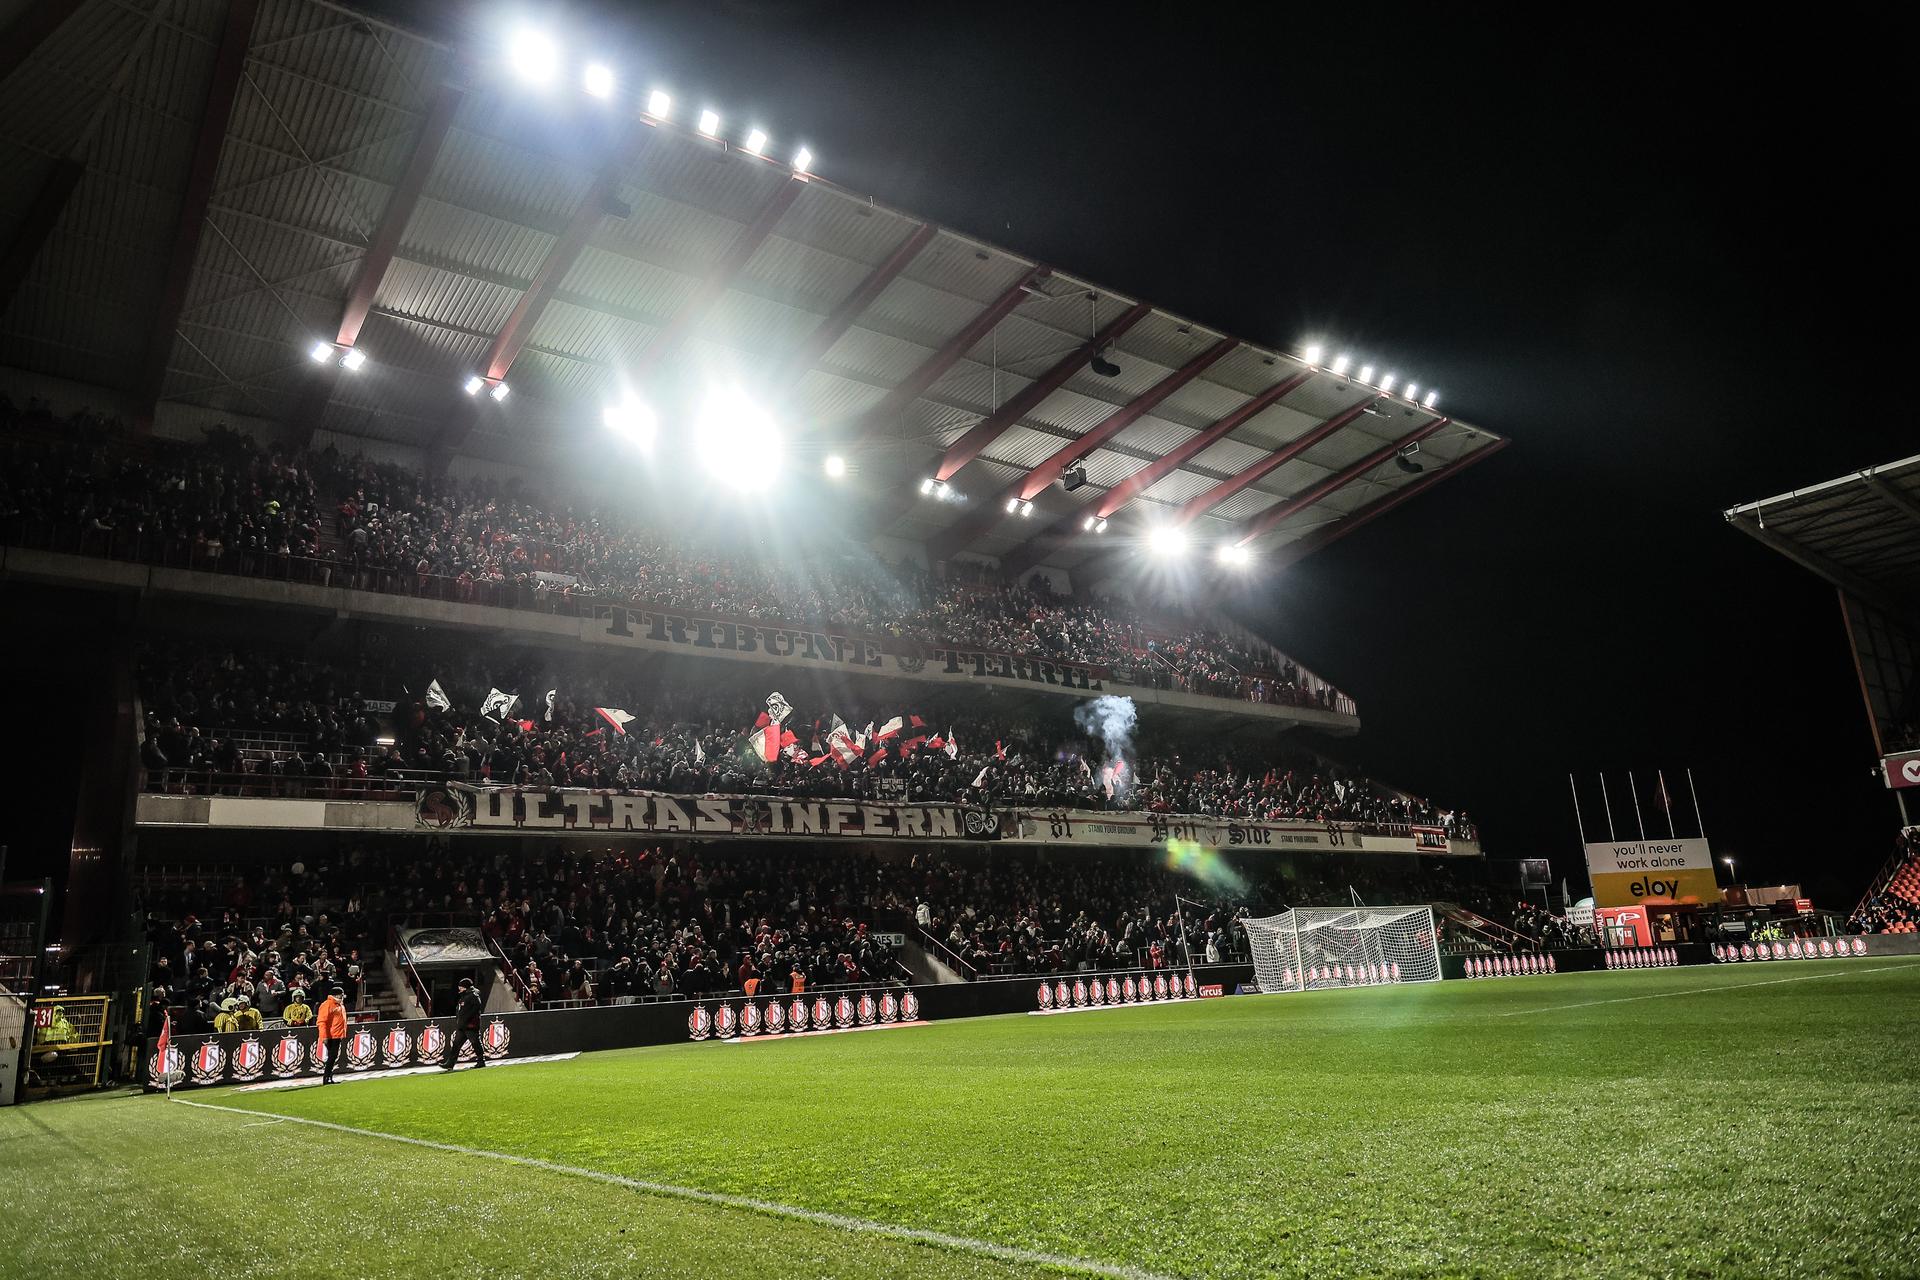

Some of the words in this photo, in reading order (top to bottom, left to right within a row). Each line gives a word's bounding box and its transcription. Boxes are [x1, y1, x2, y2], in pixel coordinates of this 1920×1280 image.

[594, 606, 883, 667] TRIBUNE
[473, 791, 733, 832] ULTRAS
[768, 801, 966, 837] INFERN
[1049, 812, 1073, 839] 81
[1088, 824, 1104, 833] STAND
[1104, 826, 1118, 834] YOUR
[1327, 824, 1345, 847] 81
[1613, 844, 1646, 857] you'll
[1649, 844, 1683, 854] never
[1617, 857, 1649, 869] work
[1651, 857, 1685, 868] alone
[1630, 876, 1679, 900] eloy
[1199, 986, 1223, 996] Circus
[39, 1009, 52, 1026] 31
